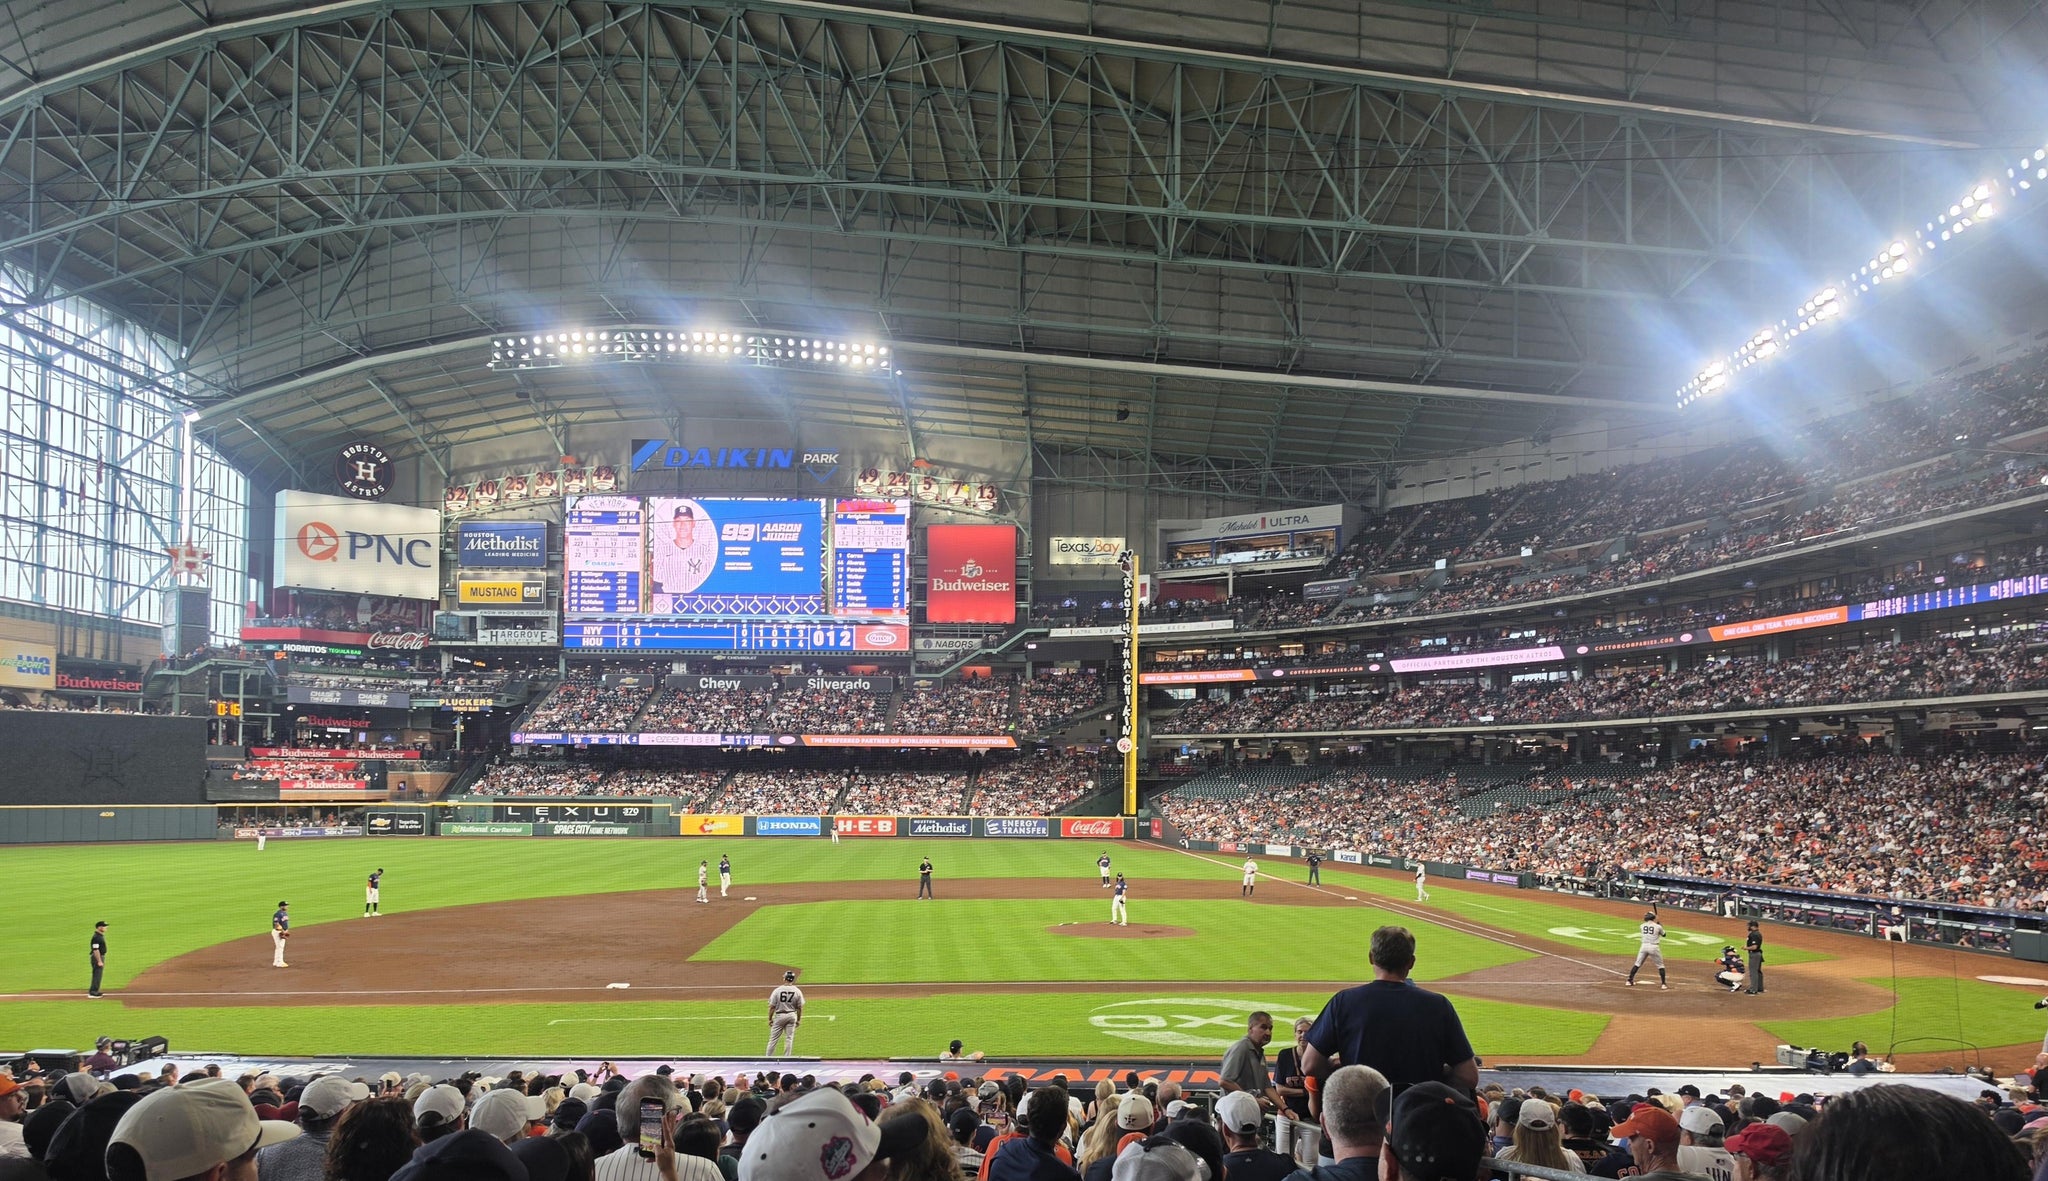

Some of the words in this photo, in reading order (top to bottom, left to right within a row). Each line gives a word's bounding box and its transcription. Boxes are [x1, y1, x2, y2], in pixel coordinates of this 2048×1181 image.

[343, 444, 388, 464] HOUSTON
[664, 447, 794, 468] DAIKIN
[802, 454, 840, 464] PARK
[355, 461, 376, 482] H
[564, 469, 585, 483] 34
[592, 466, 612, 480] 42
[858, 469, 878, 482] 49
[505, 477, 525, 490] 25
[536, 472, 555, 486] 33
[888, 472, 908, 486] 24
[924, 477, 932, 490] 5
[344, 480, 384, 496] ASTROS
[446, 487, 466, 500] 32
[476, 481, 496, 495] 40
[954, 481, 962, 495] 7
[978, 485, 996, 499] 13
[1218, 520, 1258, 533] Michelob
[1270, 515, 1309, 527] ULTRA
[721, 524, 755, 541] 99
[762, 524, 802, 532] AARON
[762, 533, 800, 542] JUDGE
[345, 530, 431, 568] PNC
[465, 536, 539, 550] Methodist
[1055, 539, 1089, 552] Texas
[1095, 539, 1120, 556] Bay
[178, 548, 206, 574] H
[470, 587, 517, 597] MUSTANG
[524, 586, 541, 597] CAT
[1990, 586, 1998, 597] R
[2014, 582, 2023, 593] H
[2003, 588, 2009, 597] 2
[1123, 577, 1133, 618] ROOT
[583, 626, 602, 635] NYY
[1122, 622, 1131, 634] 4
[490, 631, 547, 642] HARGROVE
[813, 631, 824, 646] 0
[826, 631, 835, 646] 1
[840, 631, 851, 646] 2
[283, 644, 327, 654] HORNITOS
[936, 640, 974, 648] NABORS
[1122, 638, 1132, 669] THA
[0, 658, 44, 669] FREEPORT
[17, 655, 50, 675] LNG
[56, 674, 142, 691] Budweiser
[699, 677, 740, 690] Chevy
[807, 678, 870, 690] Silverado
[217, 702, 241, 717] 0:16
[1122, 674, 1132, 735] CHIKIN
[308, 715, 371, 728] Budweiser
[622, 735, 630, 744] K
[306, 781, 356, 789] Budweiser
[554, 825, 575, 834] SPACE
[575, 825, 590, 834] CITY
[838, 820, 892, 832] H-E-B
[914, 822, 967, 834] Methodist
[1643, 926, 1654, 935] 99
[780, 992, 795, 1003] 67
